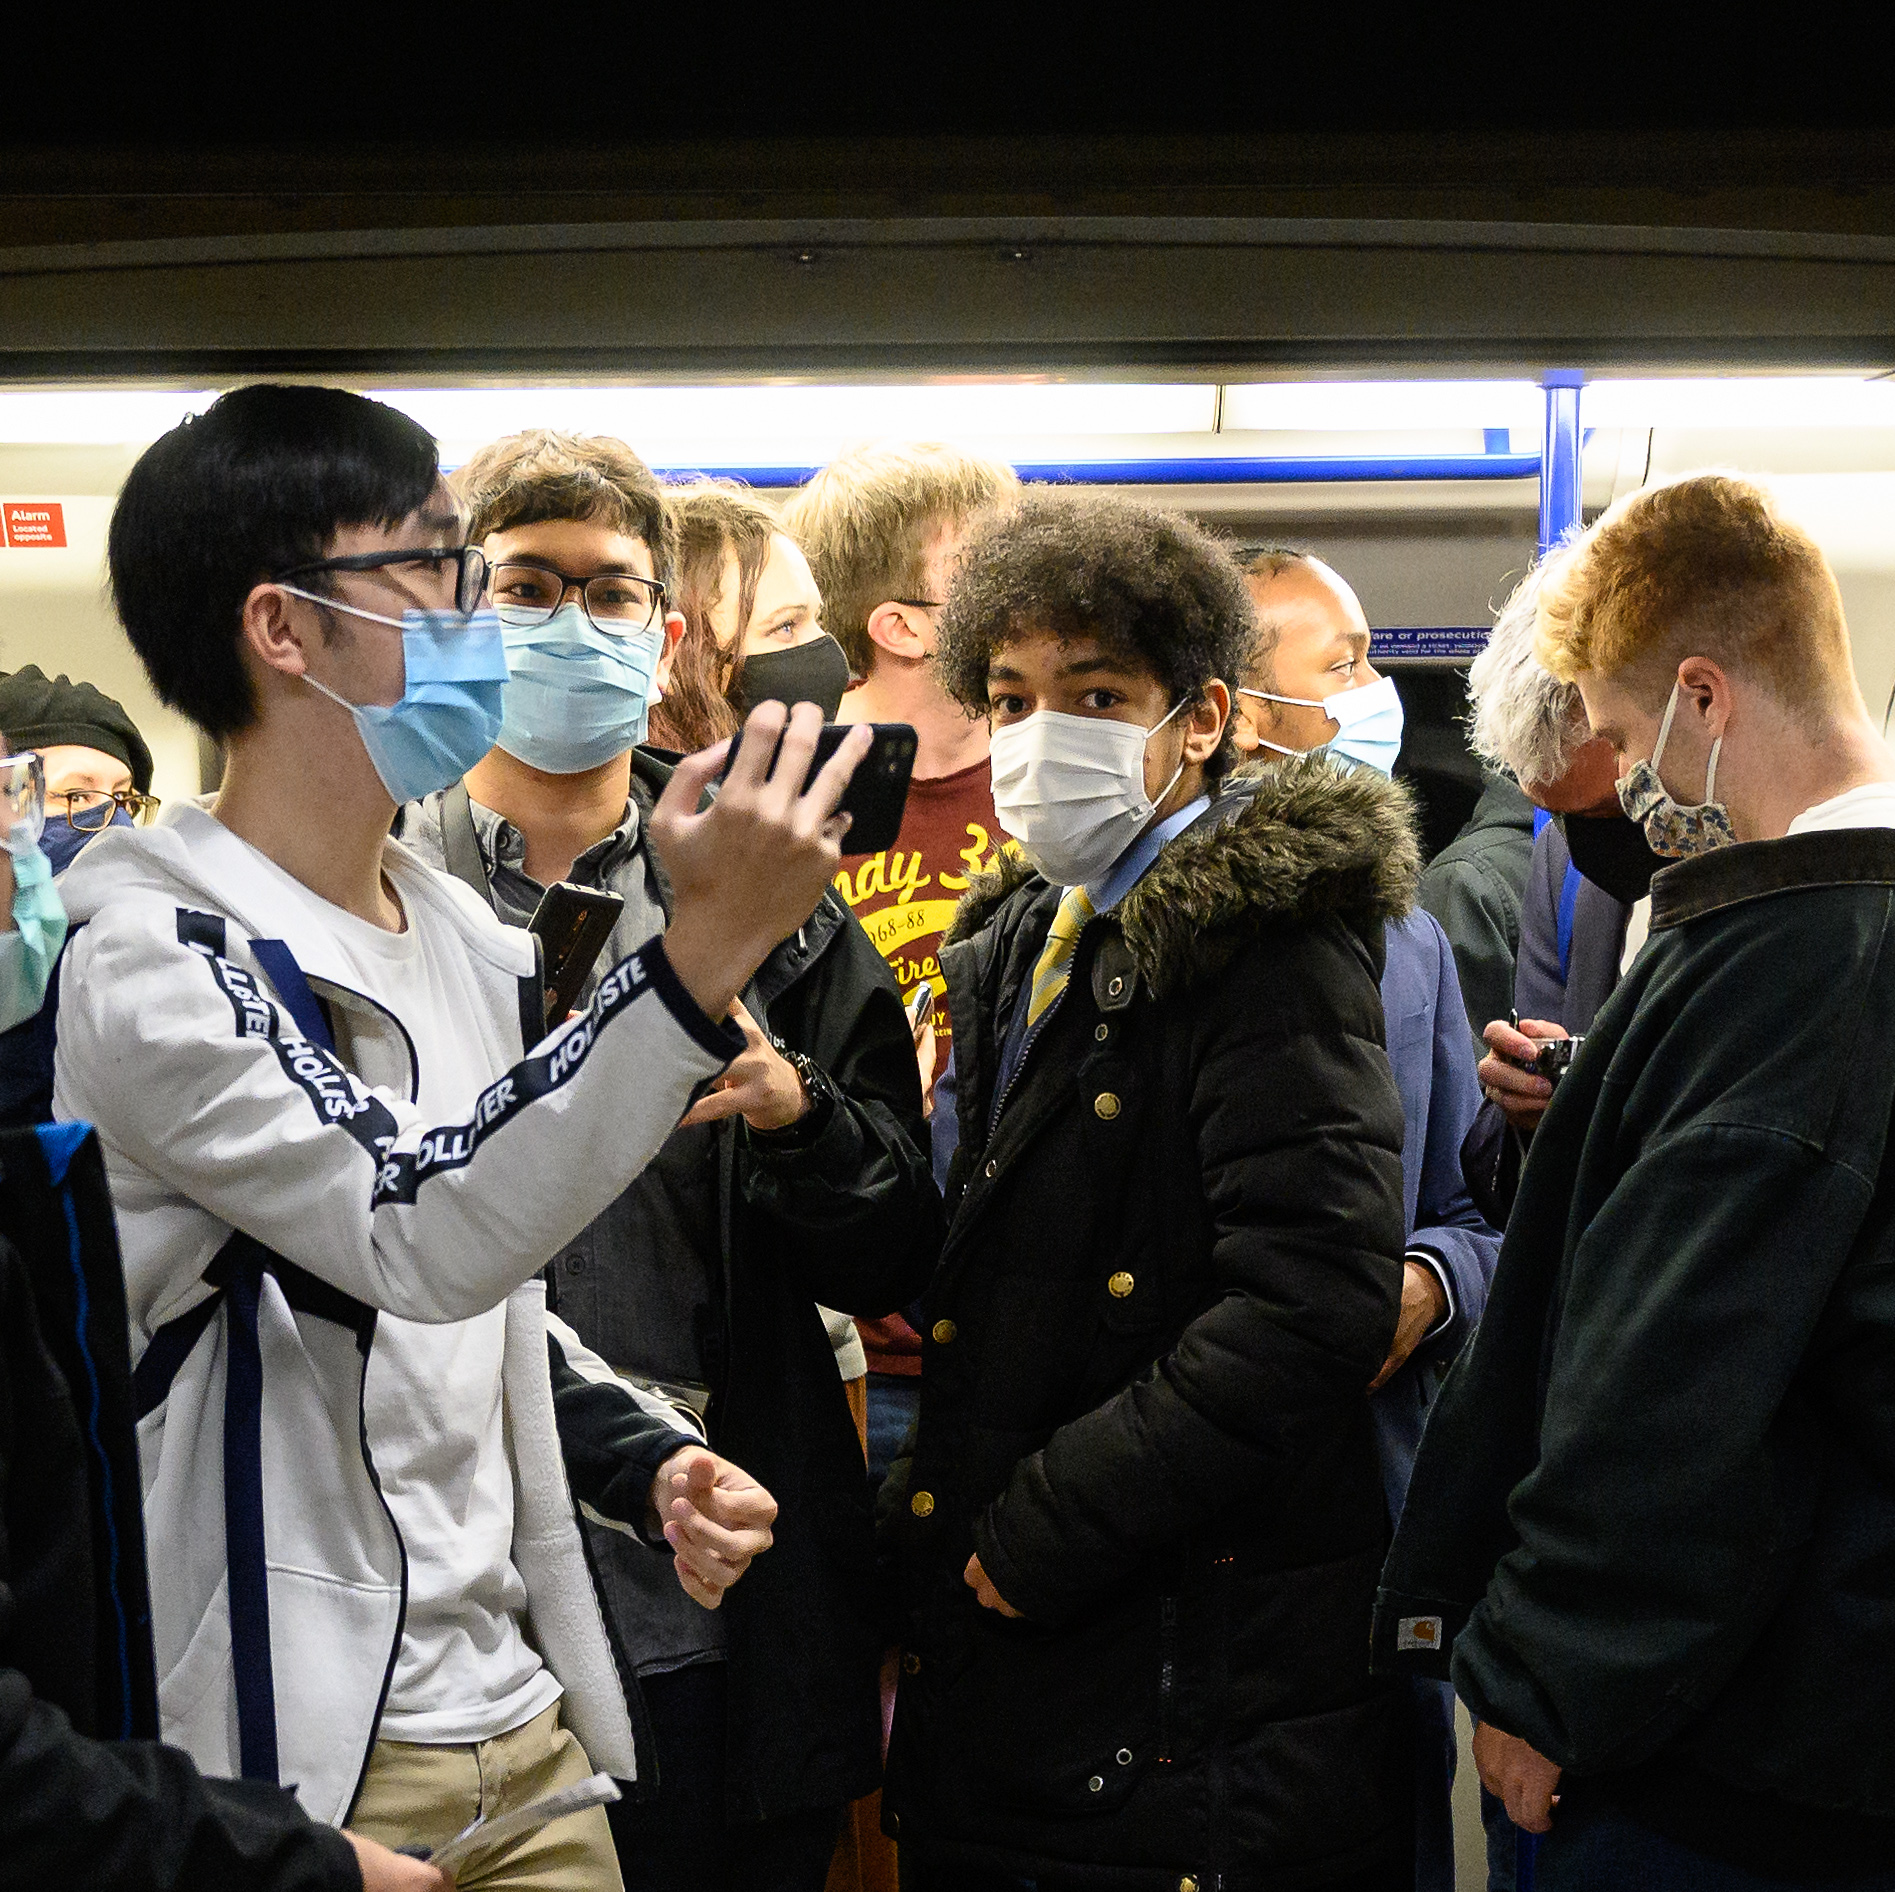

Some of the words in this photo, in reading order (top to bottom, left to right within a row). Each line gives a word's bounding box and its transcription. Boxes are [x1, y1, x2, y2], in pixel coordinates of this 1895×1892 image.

[11, 510, 51, 521] Alarm
[12, 525, 49, 533] Located
[13, 533, 53, 542] opposite
[1398, 632, 1413, 640] or
[1417, 630, 1491, 641] prosecutio
[832, 850, 932, 907] ndy
